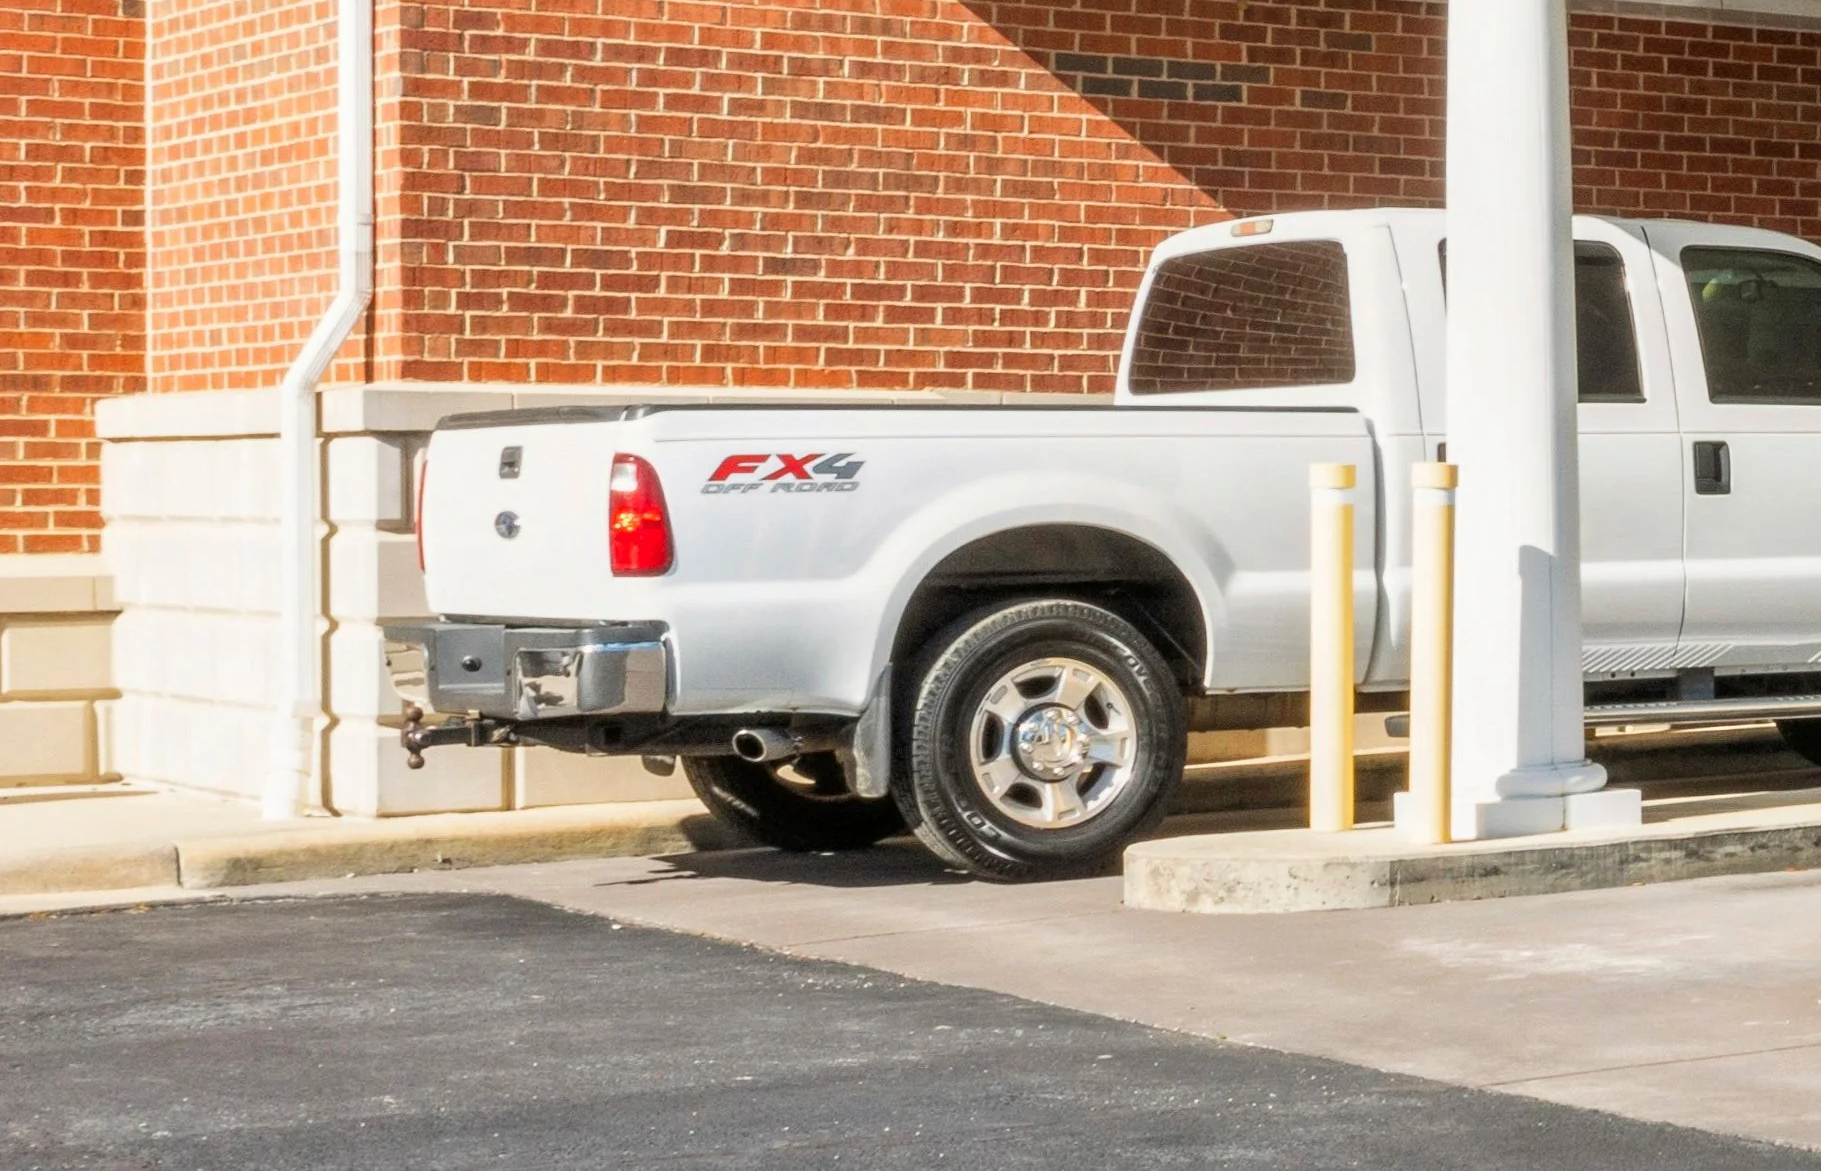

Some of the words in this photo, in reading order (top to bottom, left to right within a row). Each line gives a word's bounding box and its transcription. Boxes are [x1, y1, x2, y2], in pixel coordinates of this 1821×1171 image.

[706, 452, 867, 482] FX4
[700, 482, 764, 495] OFF
[769, 481, 861, 494] ROAD
